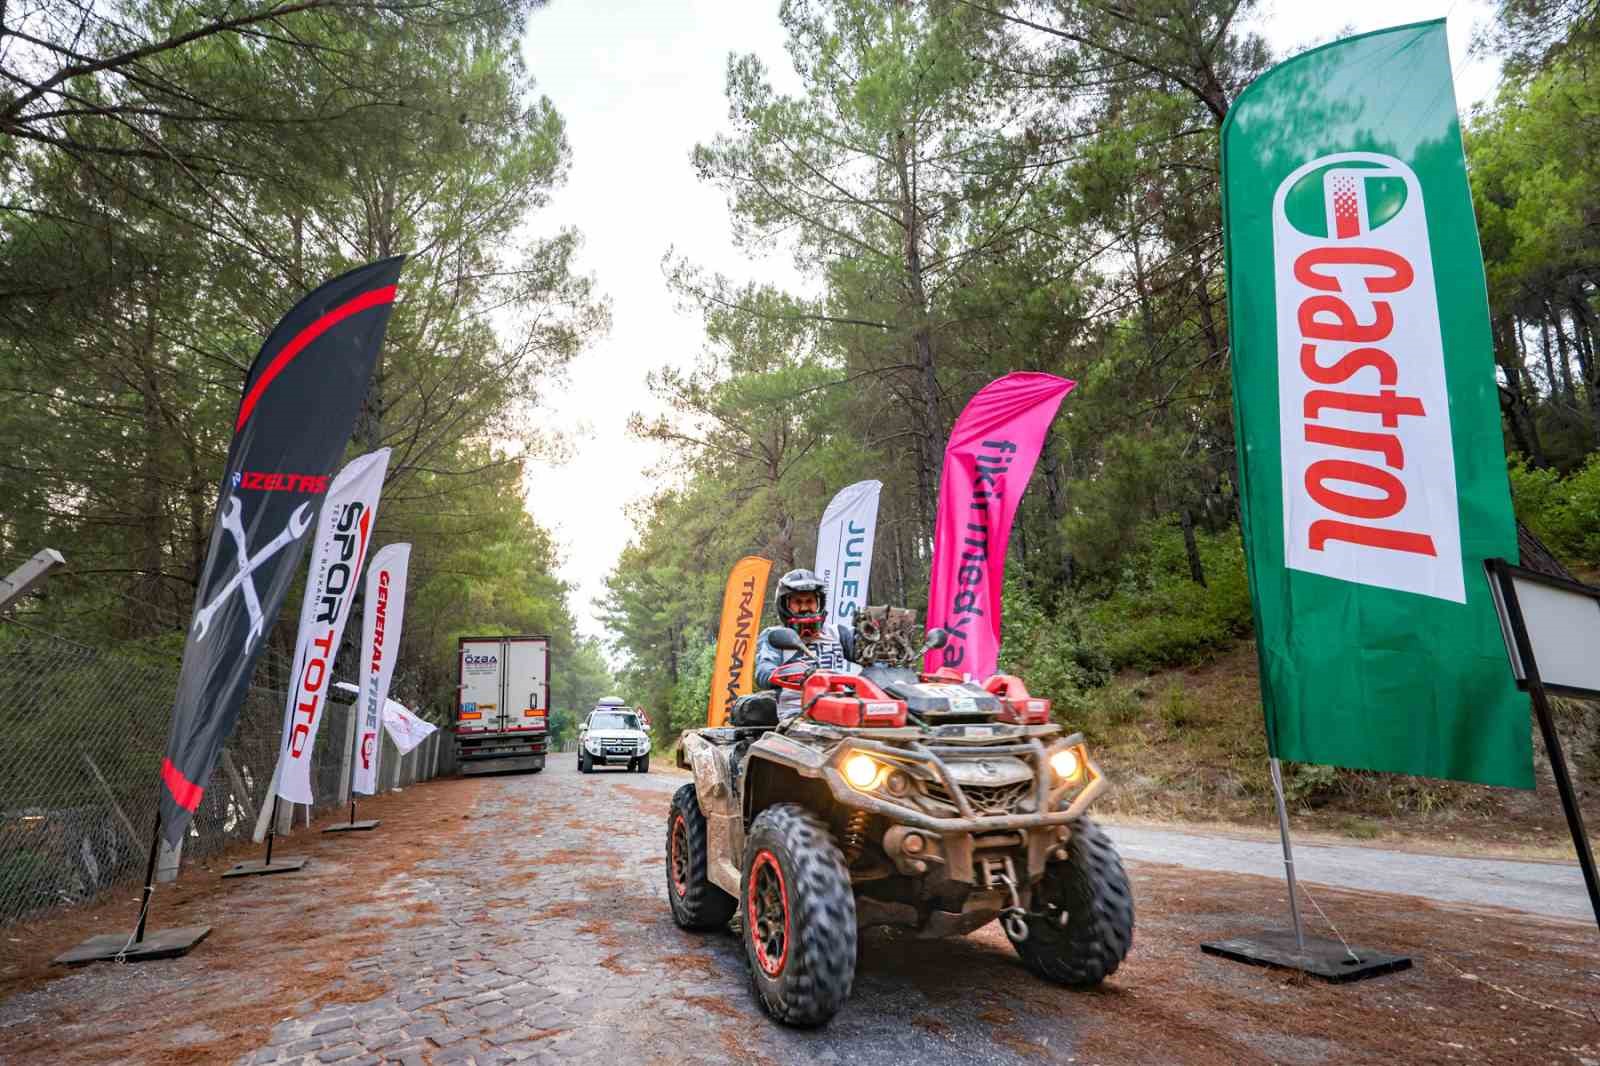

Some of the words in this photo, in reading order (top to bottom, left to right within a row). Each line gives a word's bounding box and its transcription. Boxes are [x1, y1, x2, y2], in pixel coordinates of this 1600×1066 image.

[1293, 246, 1438, 558] Castrol
[316, 500, 363, 626] SPOR
[838, 519, 866, 618] JULES
[942, 440, 1017, 668] fikirmedya
[369, 569, 390, 675] GENERAL
[291, 630, 335, 758] TOTO
[366, 675, 380, 729] TIRE
